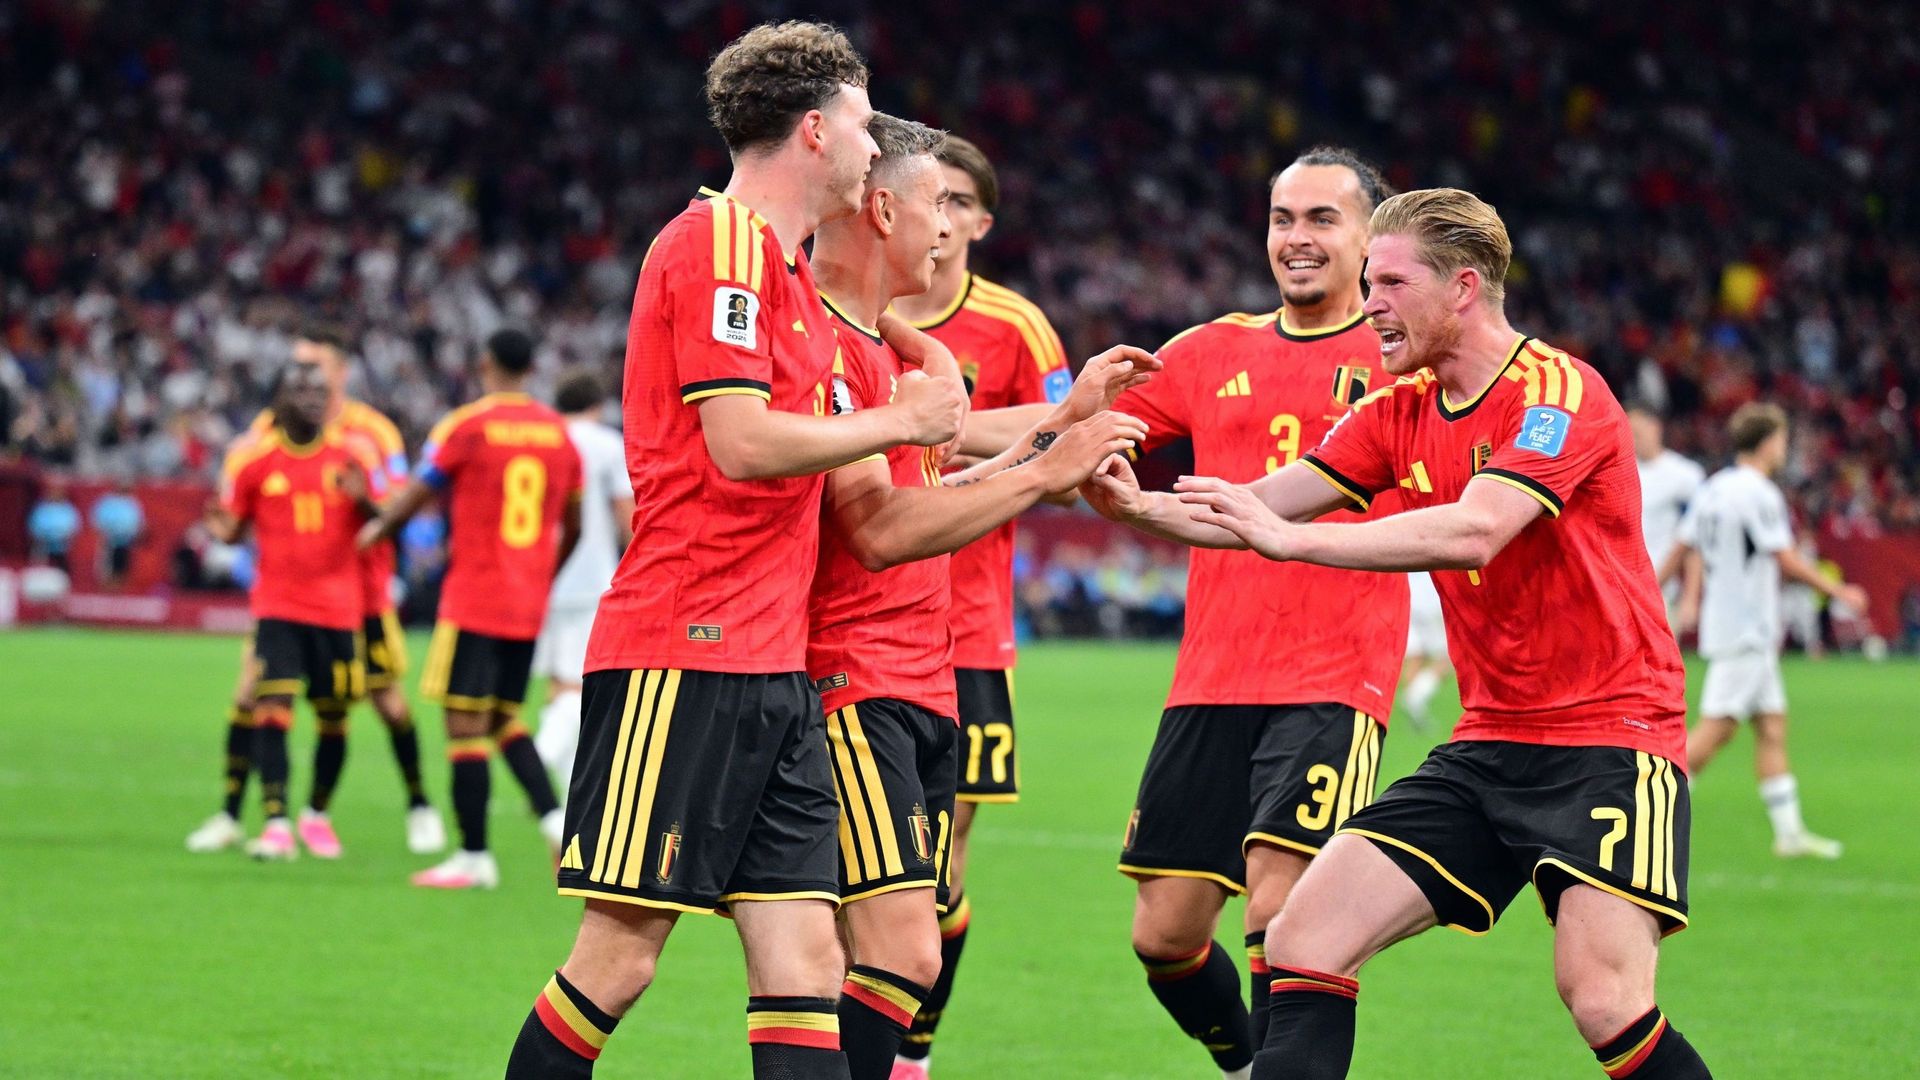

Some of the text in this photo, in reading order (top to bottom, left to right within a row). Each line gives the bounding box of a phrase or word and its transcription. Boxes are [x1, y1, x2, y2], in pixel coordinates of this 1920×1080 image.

[1265, 413, 1301, 475] 3
[1528, 430, 1552, 444] PEACE
[293, 491, 324, 534] 11
[501, 455, 546, 548] 8
[332, 659, 366, 698] 11
[966, 723, 1013, 784] 17
[1296, 764, 1339, 831] 3
[1590, 807, 1628, 872] 7
